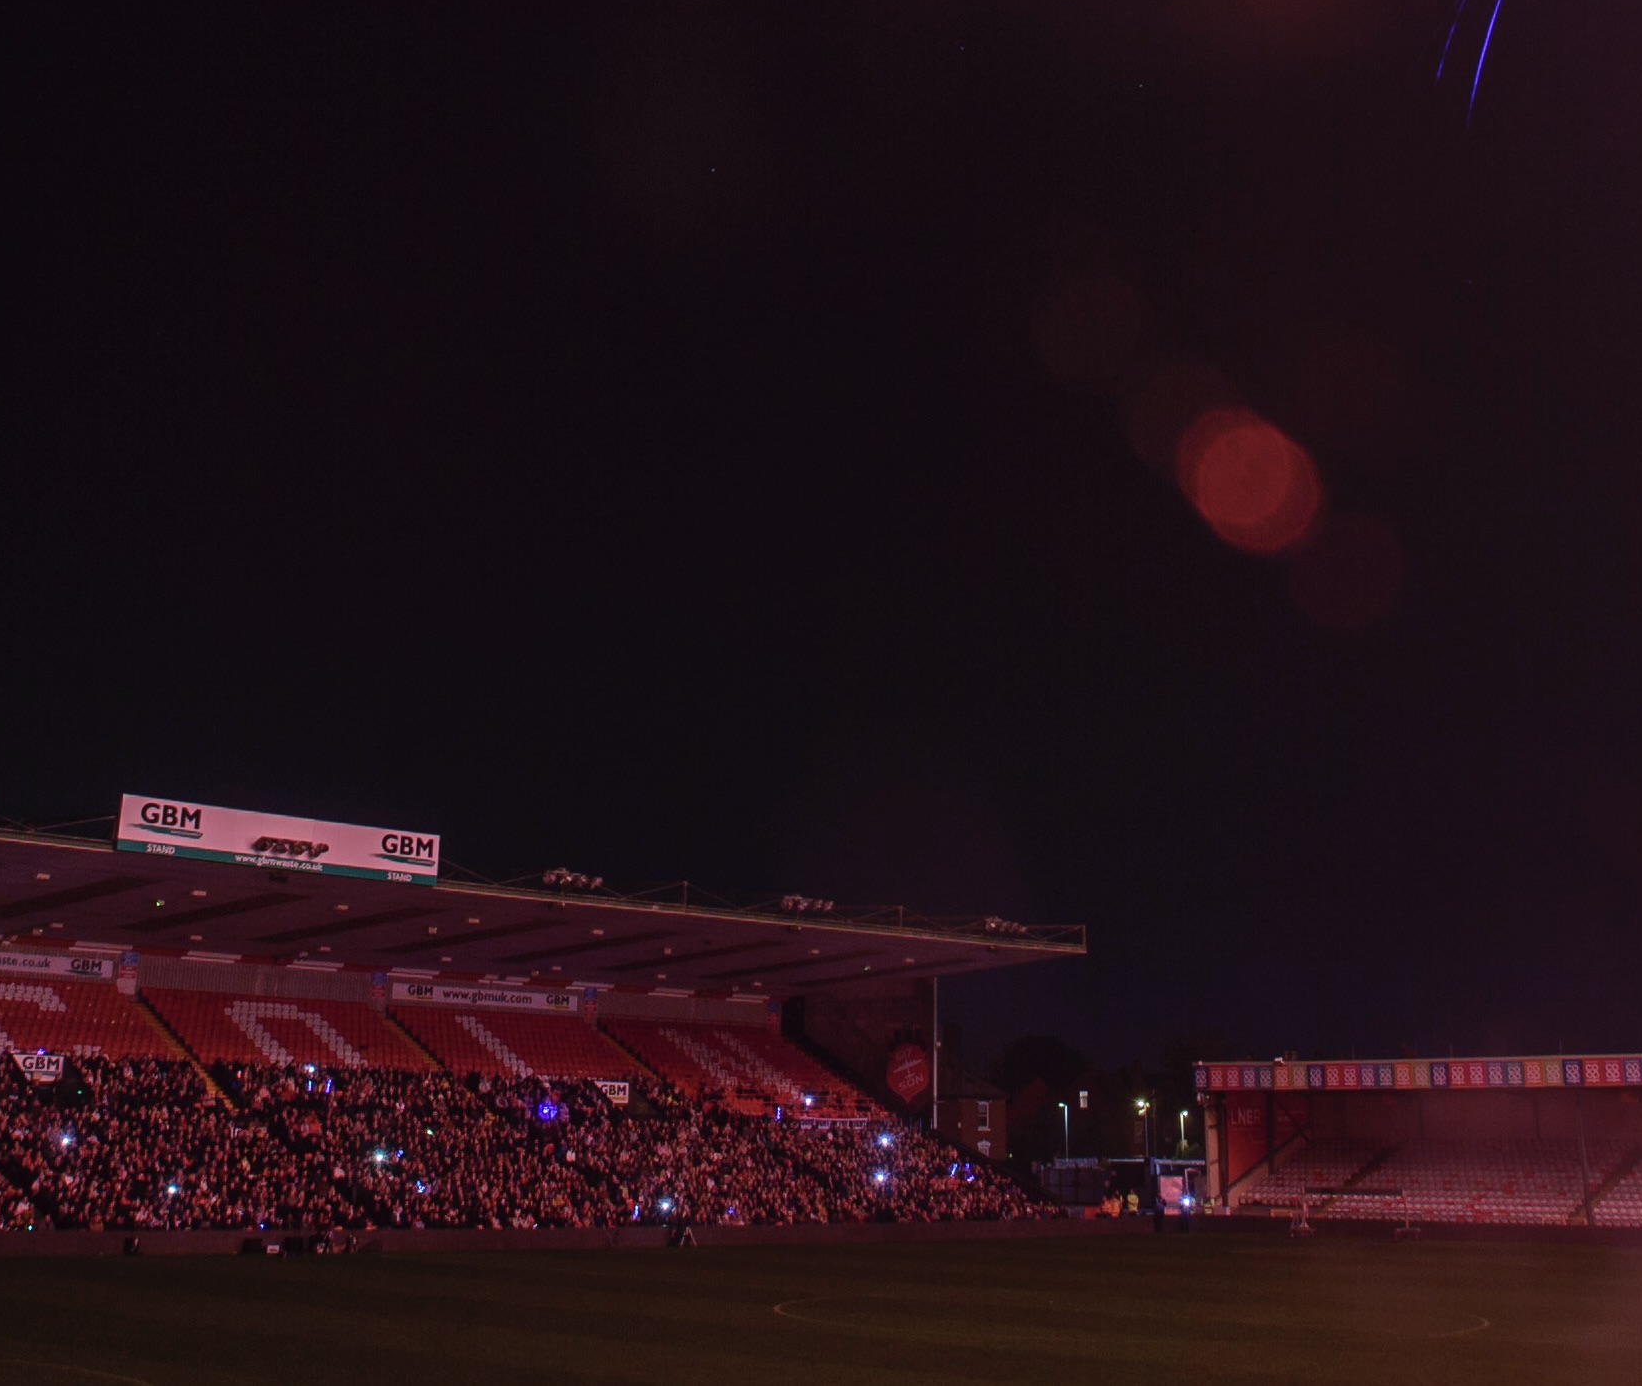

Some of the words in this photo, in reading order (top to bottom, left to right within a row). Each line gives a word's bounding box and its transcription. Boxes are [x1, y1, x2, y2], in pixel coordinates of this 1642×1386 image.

[141, 802, 202, 829] GBM
[146, 843, 176, 855] STAND
[381, 833, 434, 857] GBM
[234, 853, 324, 873] www.gbmwaste.co.uk
[386, 871, 413, 882] STAND
[70, 958, 103, 972] GBM
[408, 984, 434, 996] GBM
[443, 989, 533, 1004] www.gbmuk.com
[546, 994, 570, 1005] GBM
[23, 1056, 60, 1070] GBM
[600, 1084, 627, 1096] GBM
[1230, 1106, 1261, 1126] LNER
